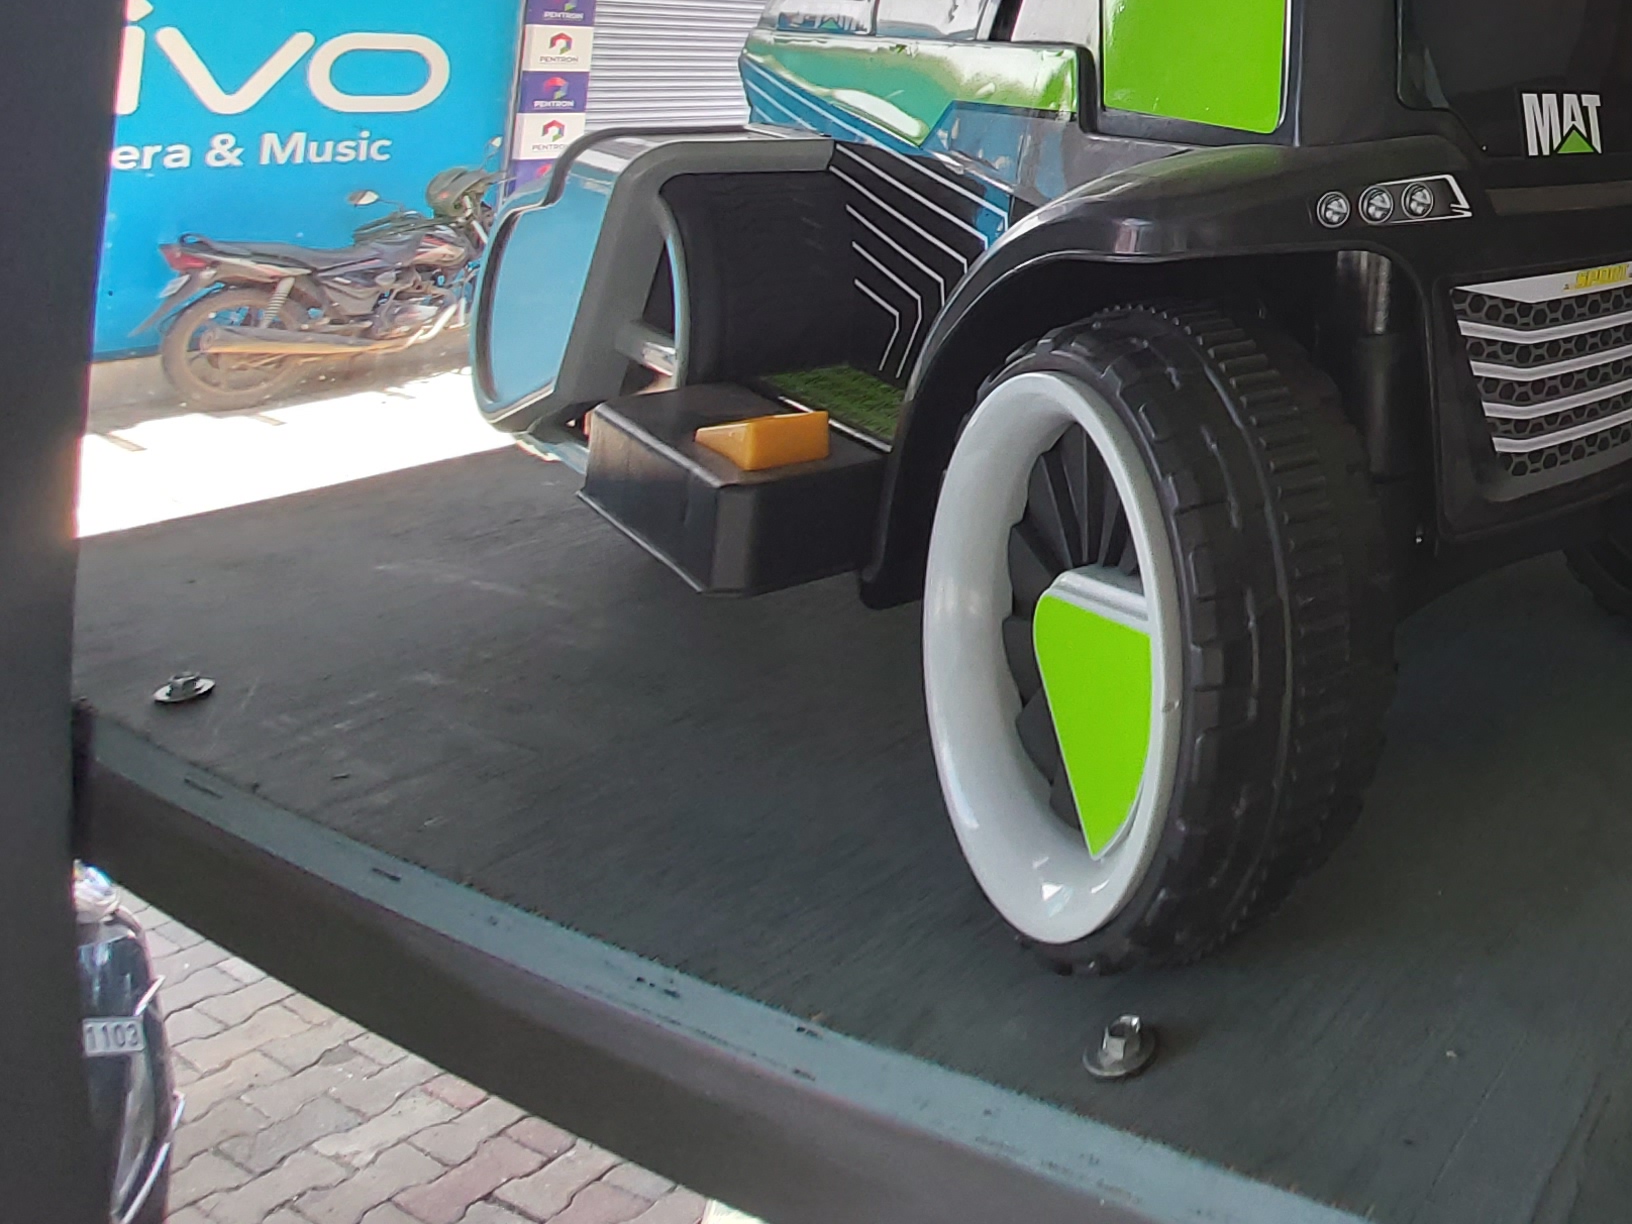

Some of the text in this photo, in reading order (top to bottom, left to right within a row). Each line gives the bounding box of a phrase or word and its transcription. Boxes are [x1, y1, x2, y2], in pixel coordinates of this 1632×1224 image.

[543, 11, 584, 21] PENTRON
[539, 56, 579, 64] PENTRON
[533, 100, 575, 110] PENTRON
[1522, 93, 1602, 156] MAT
[205, 132, 244, 168] &
[259, 130, 393, 165] Music
[532, 143, 567, 152] PENTRO
[86, 1023, 138, 1049] 1103
